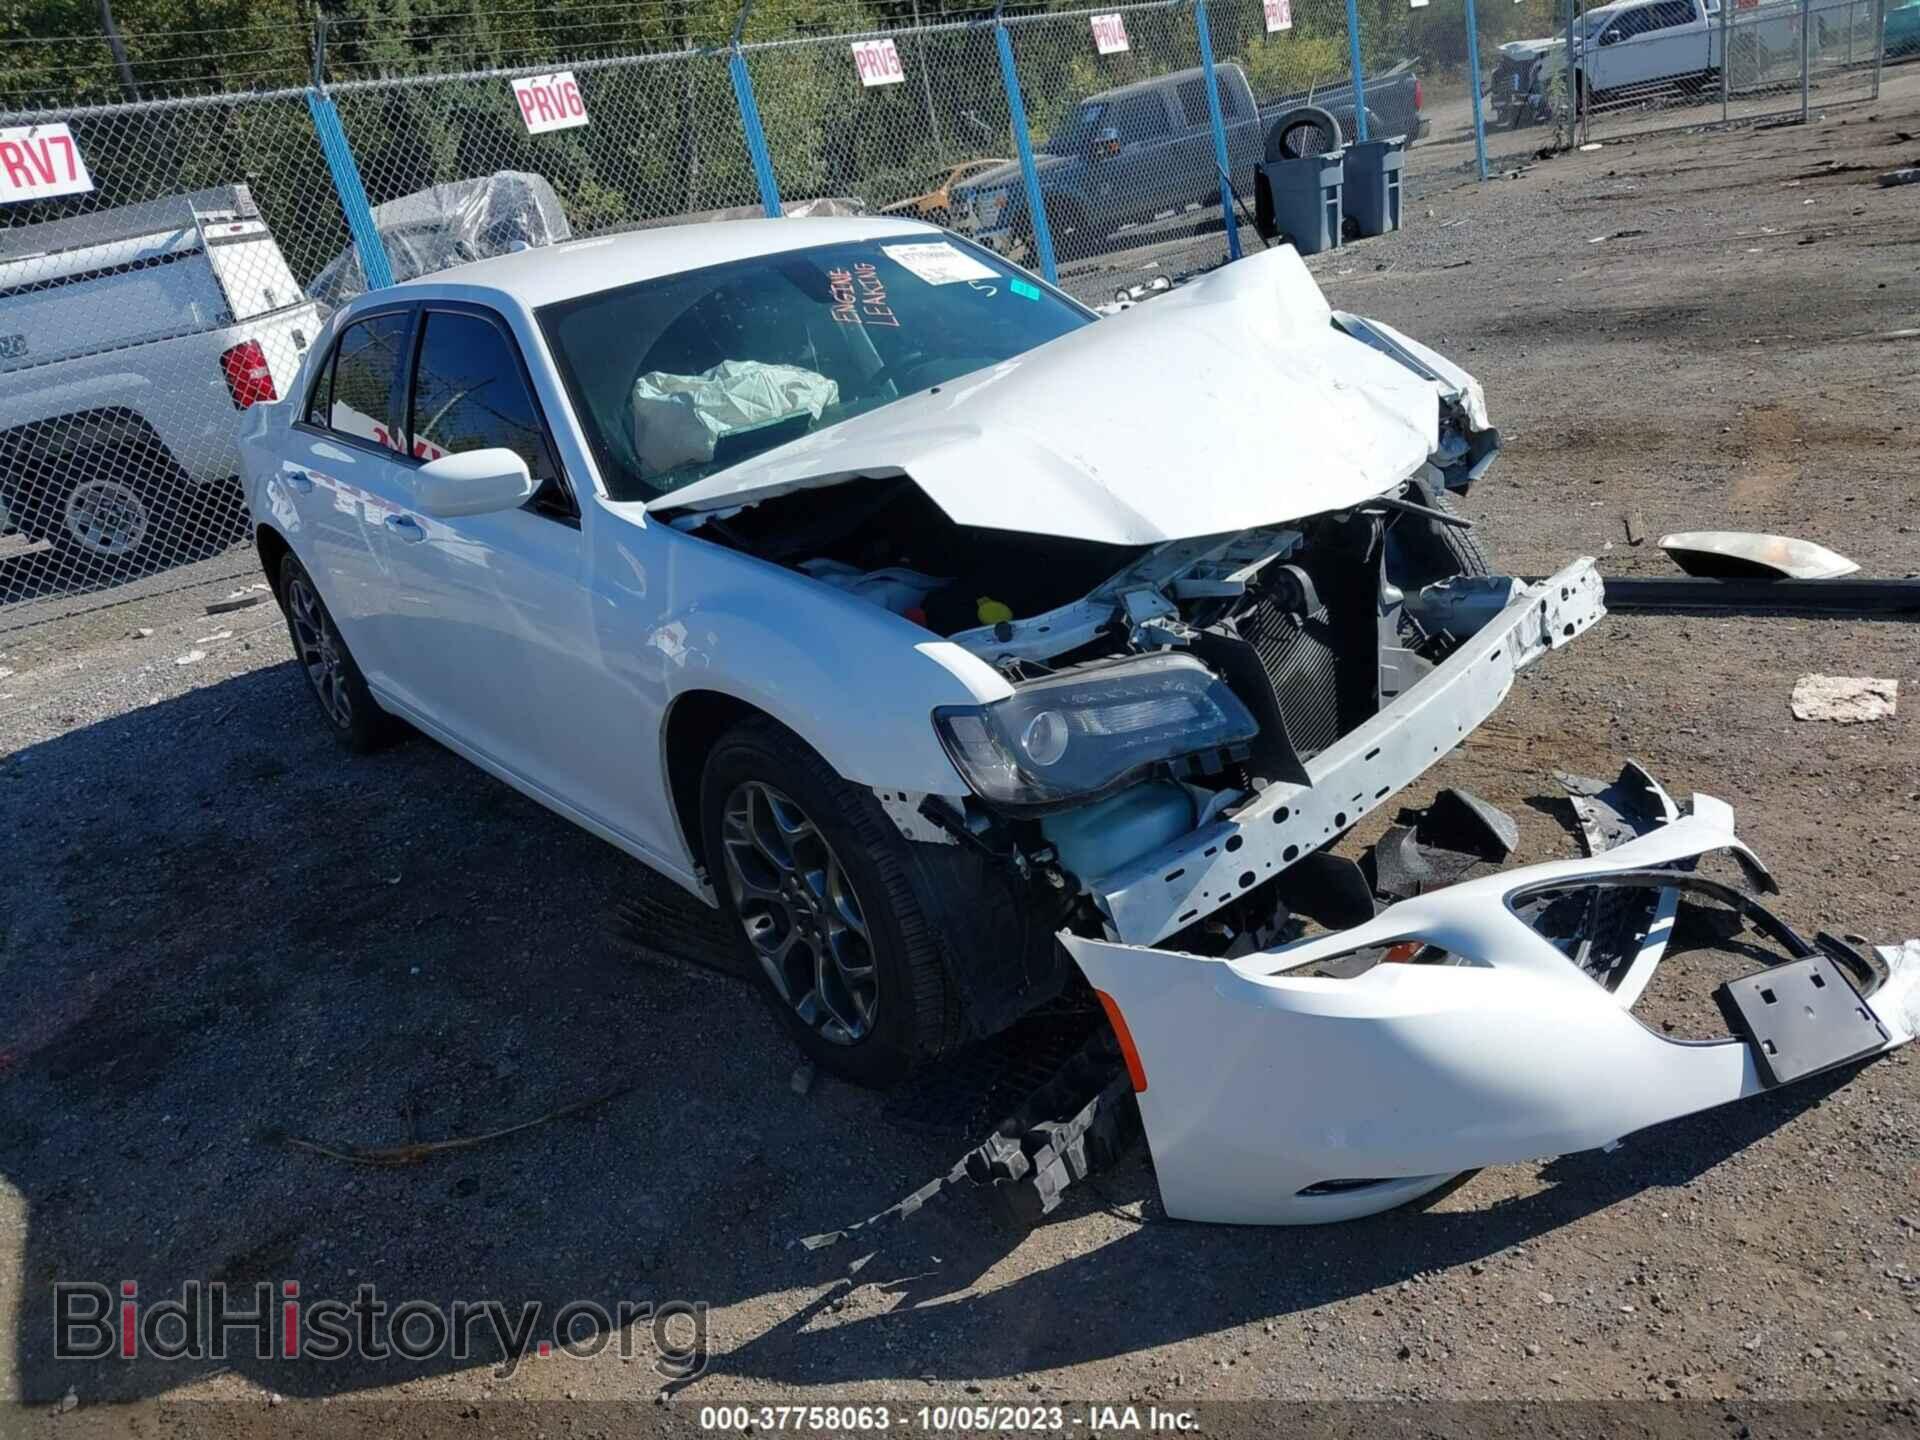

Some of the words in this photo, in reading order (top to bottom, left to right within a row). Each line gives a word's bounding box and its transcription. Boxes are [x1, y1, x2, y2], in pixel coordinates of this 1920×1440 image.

[855, 47, 901, 79] PRV5
[516, 81, 584, 126] PRV6
[828, 266, 863, 325] ENGINE
[854, 262, 901, 328] LEAKING
